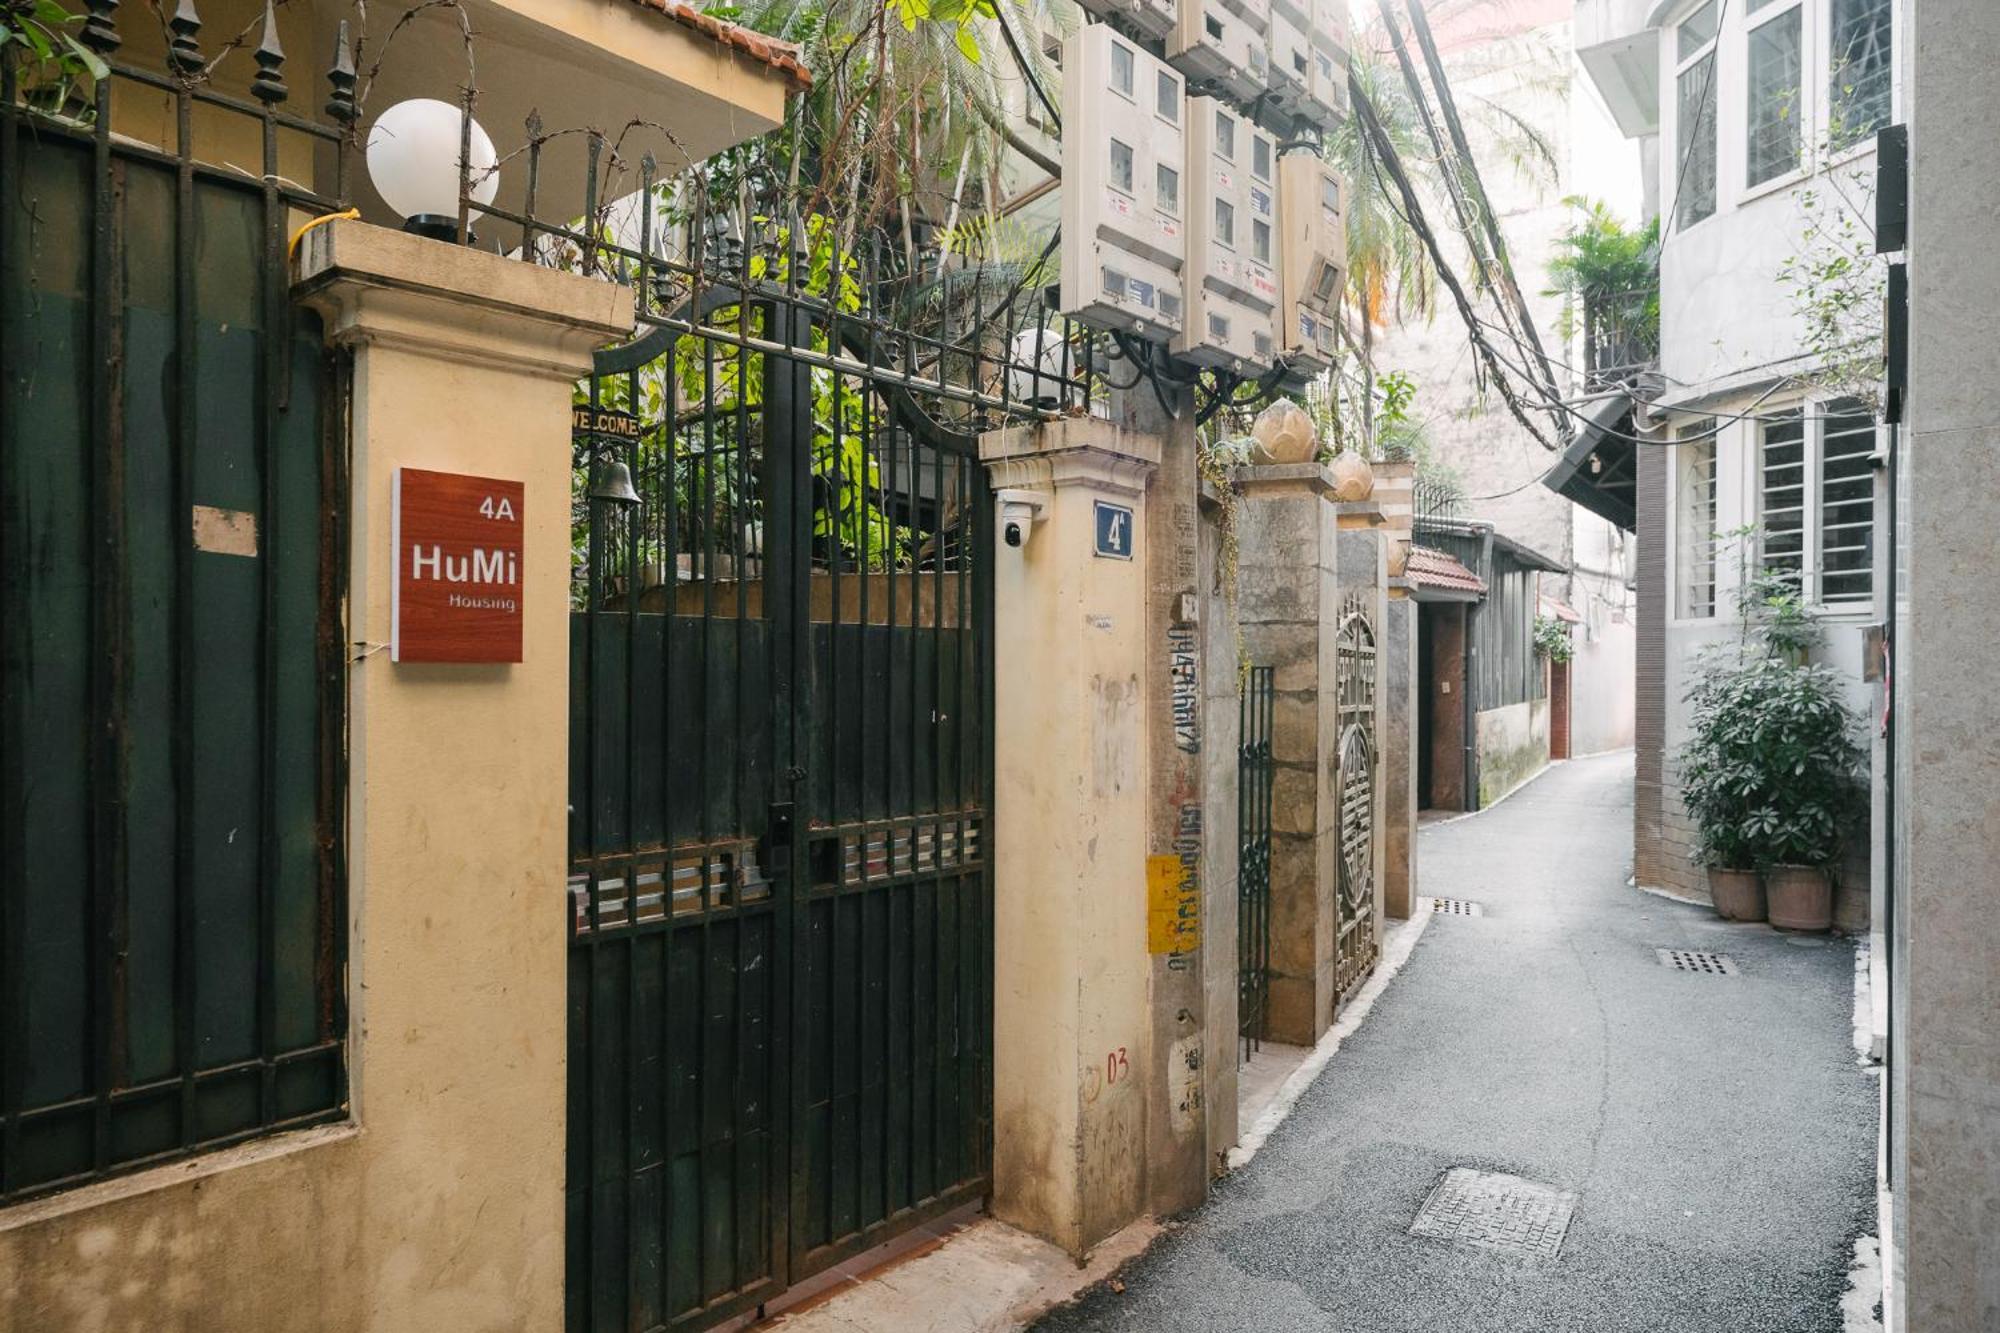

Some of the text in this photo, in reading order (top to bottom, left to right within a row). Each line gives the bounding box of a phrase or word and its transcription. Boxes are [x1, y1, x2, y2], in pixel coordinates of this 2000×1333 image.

[479, 496, 516, 521] 4A
[413, 544, 516, 585] HuMi
[449, 593, 516, 613] Housing
